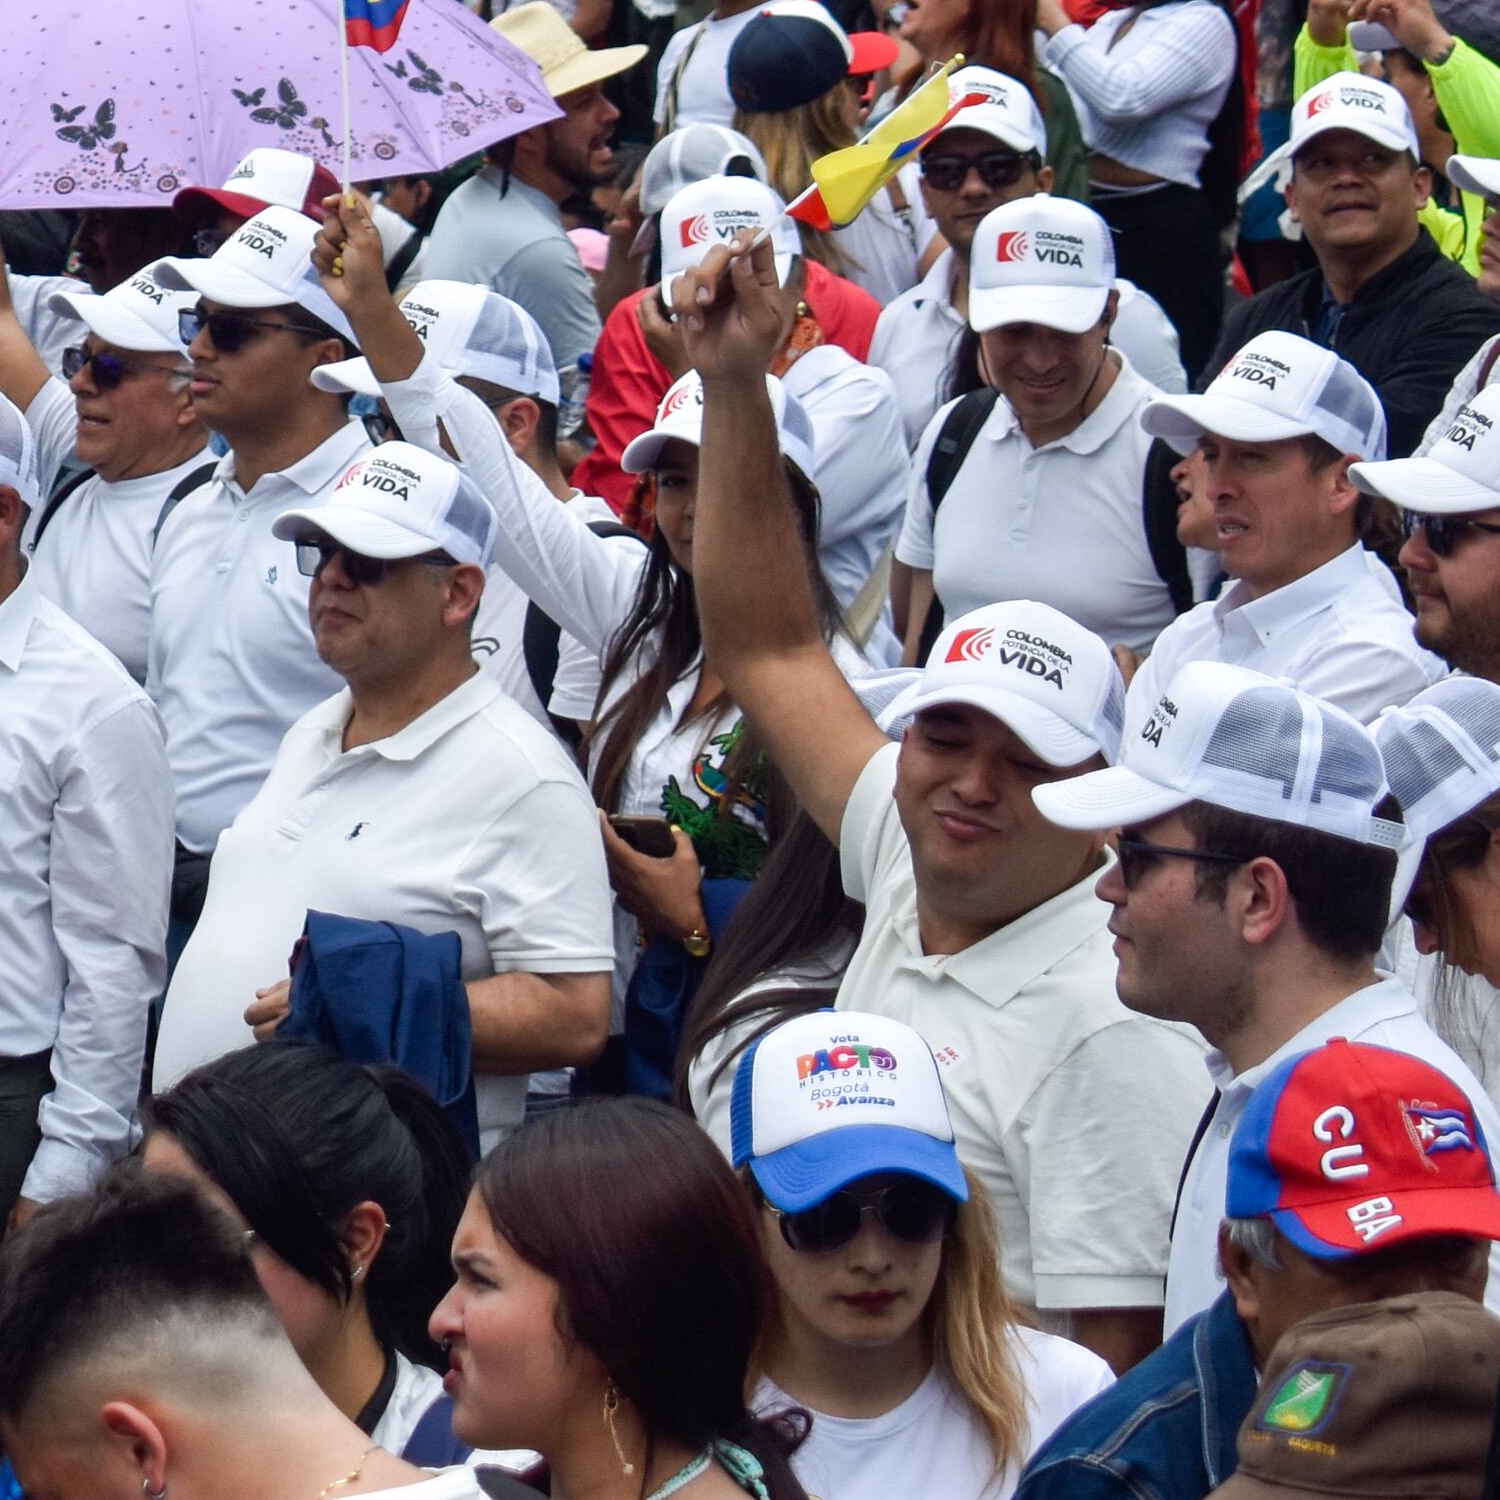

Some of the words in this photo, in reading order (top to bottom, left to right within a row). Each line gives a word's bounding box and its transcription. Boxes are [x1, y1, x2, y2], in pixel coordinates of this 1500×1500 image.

[1341, 97, 1387, 115] VIDA
[238, 232, 274, 259] VIDA
[1035, 231, 1084, 246] COLOMBIA
[1034, 248, 1083, 269] VIDA
[131, 278, 163, 305] VIDA
[408, 319, 428, 339] DA
[1245, 353, 1291, 374] COLOMBIA
[1232, 366, 1276, 390] VIDA
[372, 459, 421, 482] COLOMBIA
[363, 473, 408, 501] VIDA
[1002, 639, 1046, 660] POTENCIA
[1047, 654, 1059, 666] DE
[1058, 661, 1070, 674] LA
[1006, 629, 1073, 665] COLOMBIA
[1000, 648, 1063, 690] VIDA
[830, 1034, 860, 1044] Vota
[796, 1044, 897, 1080] PACTO
[811, 1082, 869, 1101] Bogotá
[836, 1095, 896, 1107] Avanza
